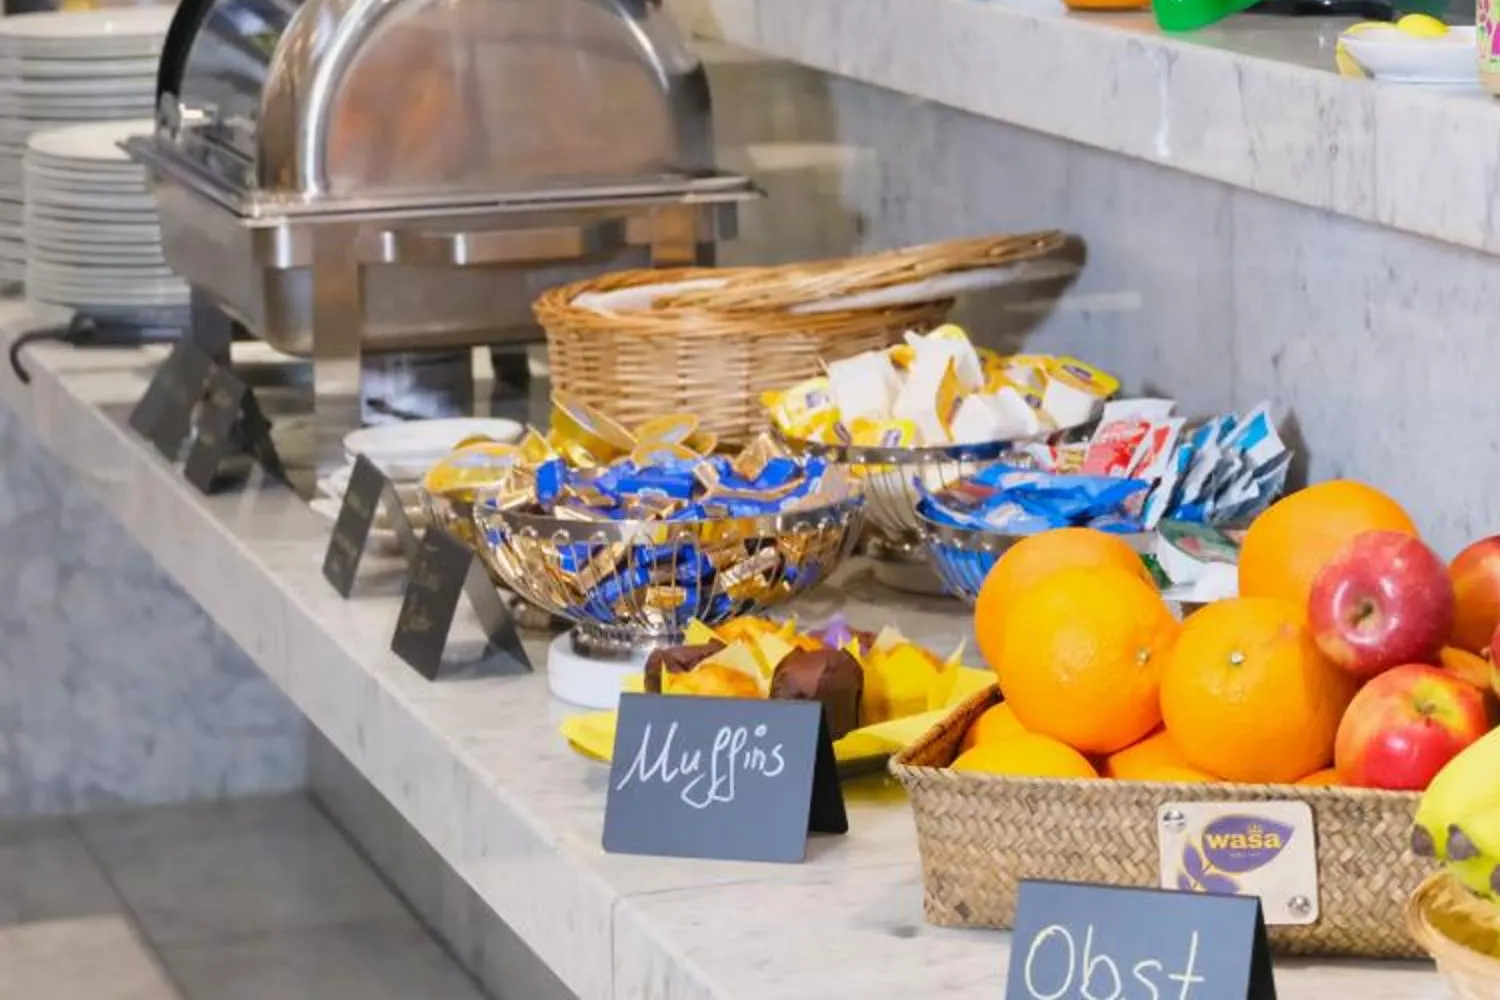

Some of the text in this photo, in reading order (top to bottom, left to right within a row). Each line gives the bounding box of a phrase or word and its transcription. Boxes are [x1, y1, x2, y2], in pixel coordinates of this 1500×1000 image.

[616, 721, 786, 809] Muffins
[1205, 832, 1281, 850] wasa
[1024, 924, 1206, 1000] Obst
